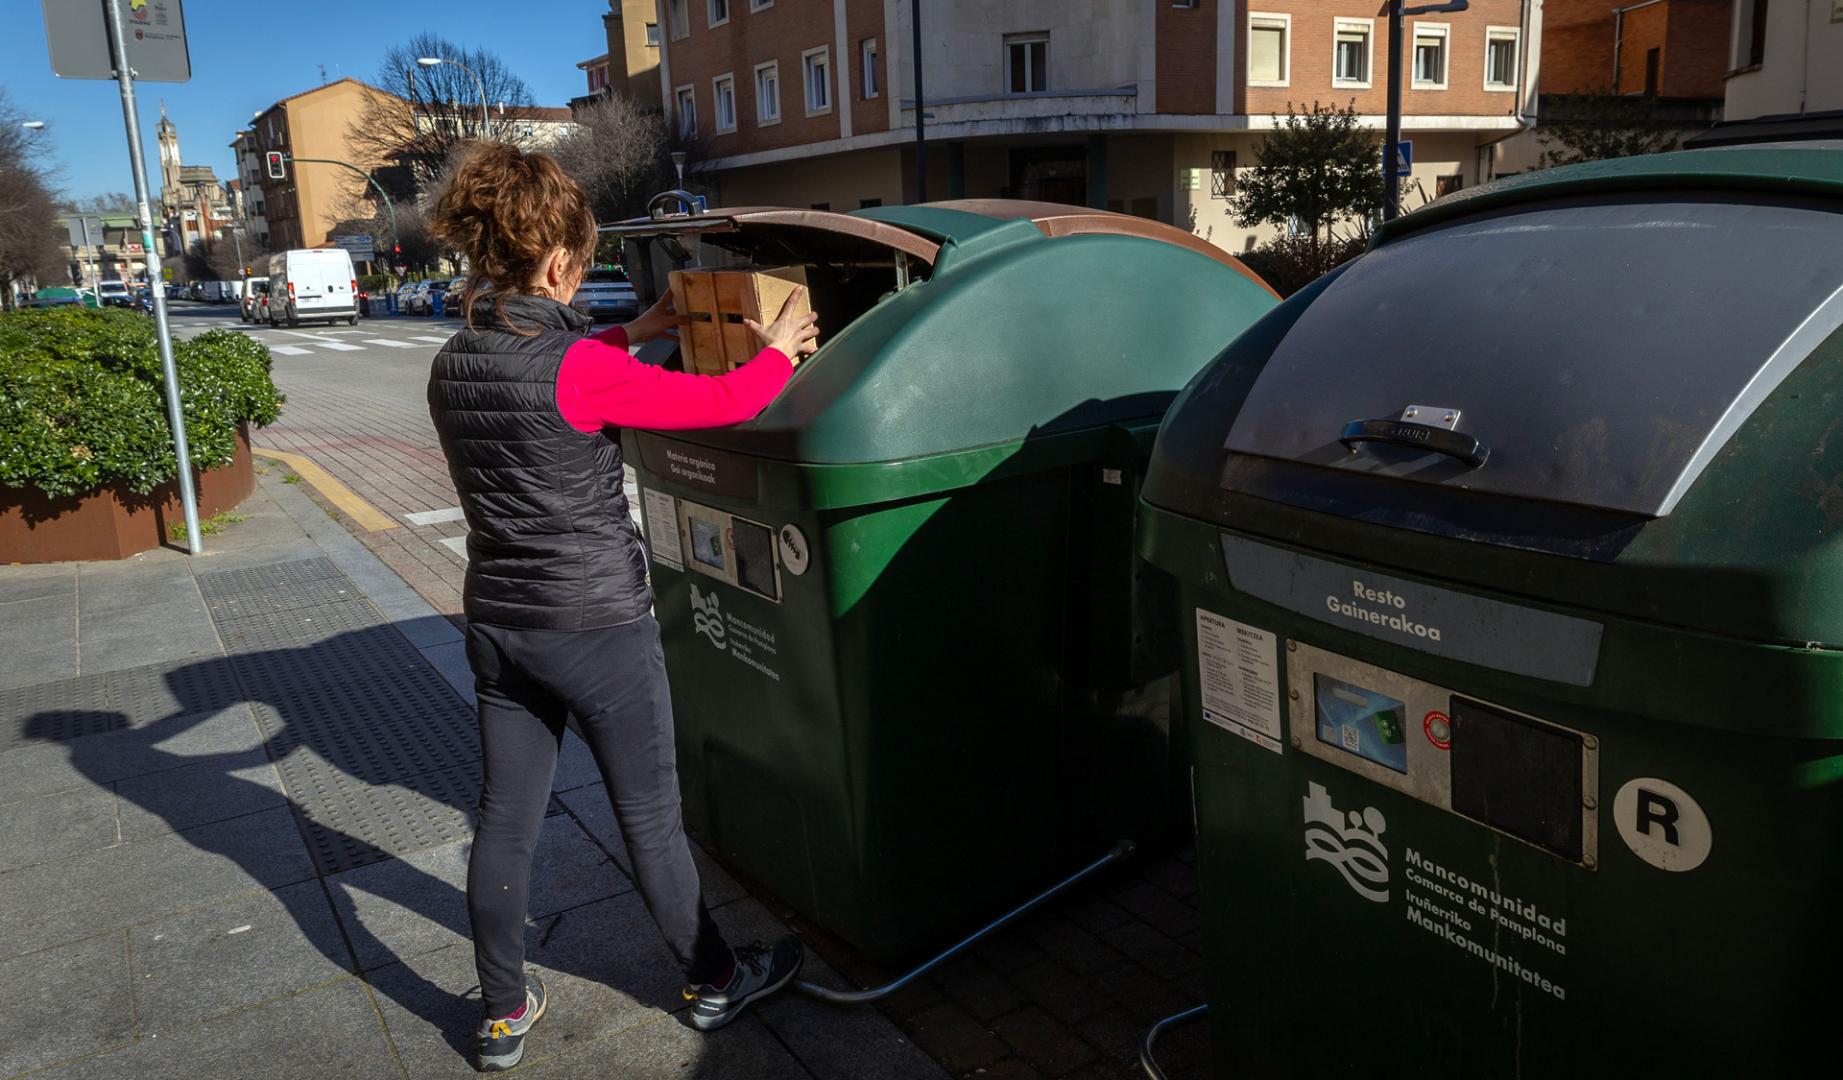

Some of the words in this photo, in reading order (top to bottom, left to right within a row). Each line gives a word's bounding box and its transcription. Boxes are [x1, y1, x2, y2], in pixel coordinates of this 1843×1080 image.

[670, 463, 681, 474] Gai
[1326, 595, 1441, 641] Gainerakoa
[1353, 580, 1406, 609] Resto
[1636, 788, 1680, 847] R
[1405, 847, 1566, 936] Mancomunidad
[1405, 868, 1464, 905] Comarca
[1468, 898, 1486, 916] de
[1490, 907, 1566, 956] Pamplona
[1406, 889, 1472, 932] Iruñerriko
[1406, 905, 1566, 1001] Mankomunitatea
